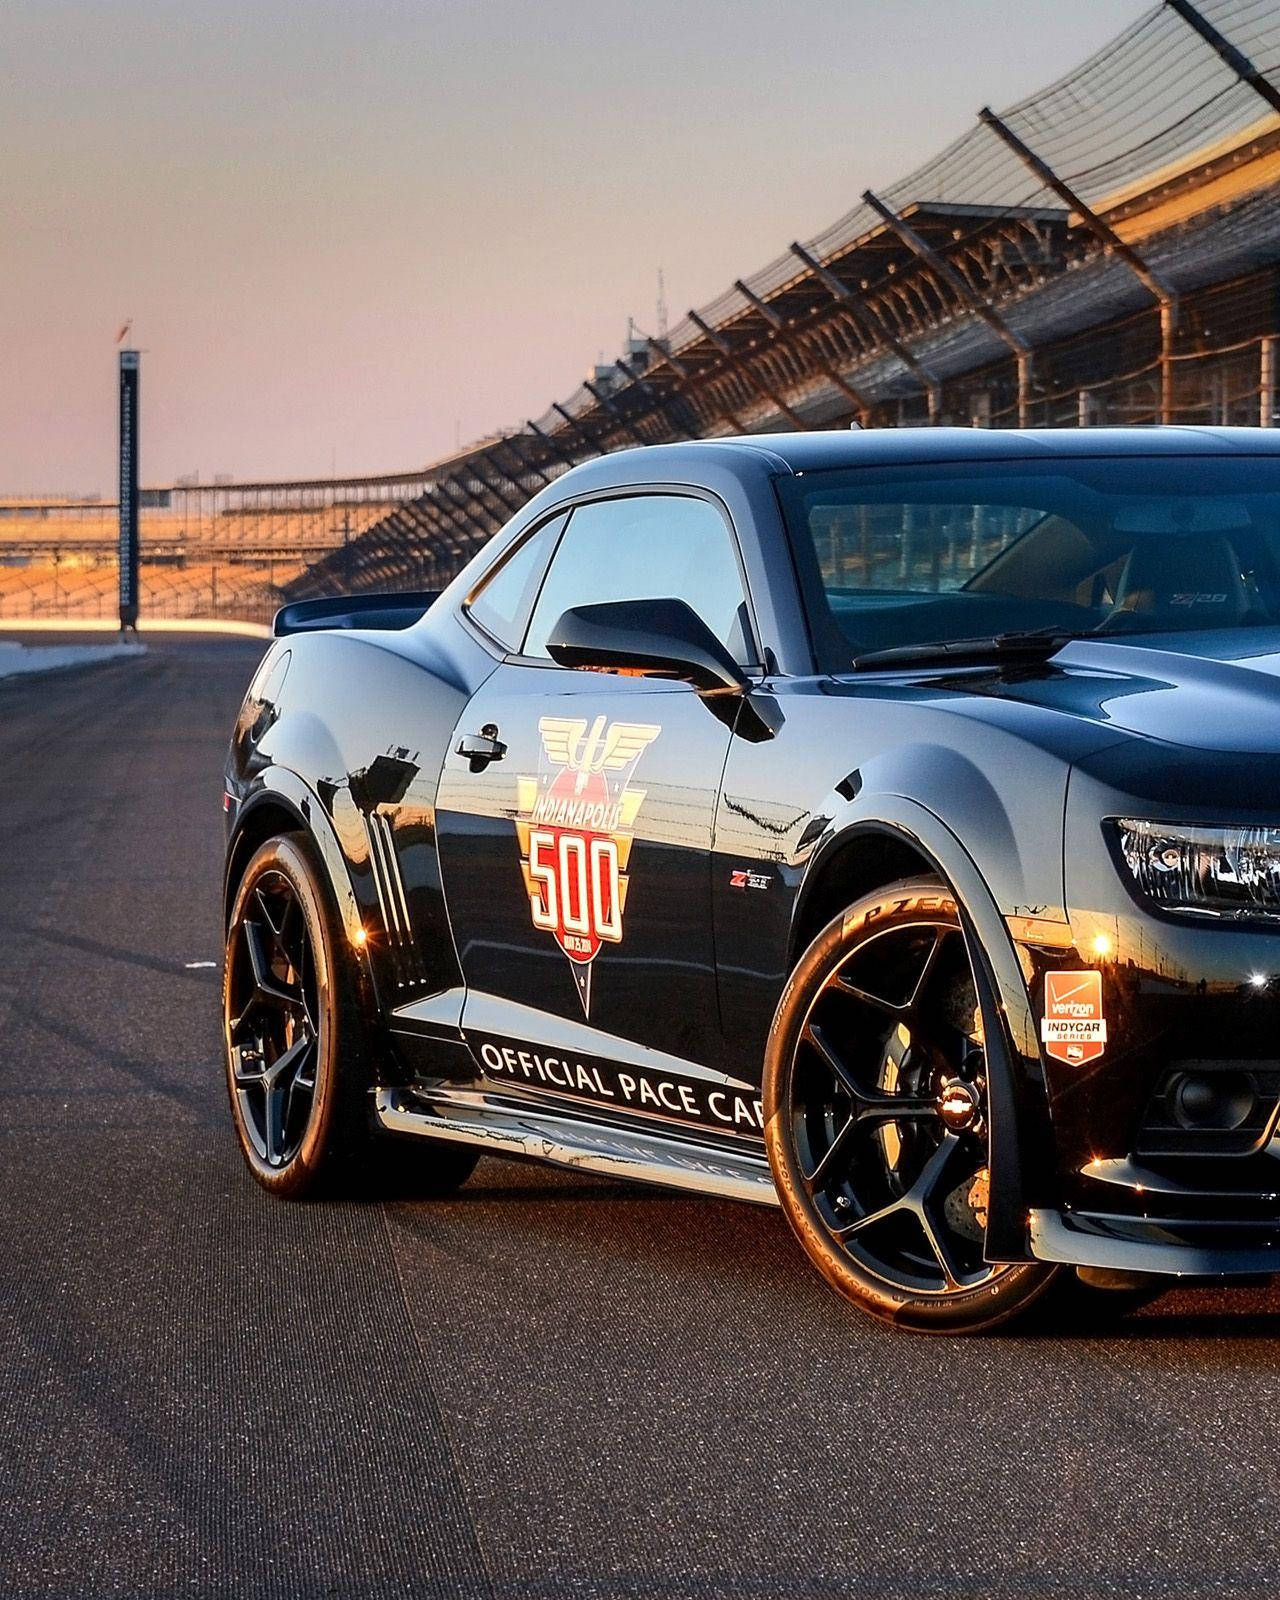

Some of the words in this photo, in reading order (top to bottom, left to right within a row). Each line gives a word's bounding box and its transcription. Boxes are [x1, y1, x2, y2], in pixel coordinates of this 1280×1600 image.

[1169, 592, 1228, 608] Z/28
[532, 795, 622, 831] INDIANAPOLIS
[528, 830, 623, 943] 500
[863, 906, 882, 926] P
[1051, 1000, 1094, 1017] verizon
[1048, 1022, 1100, 1032] INDYCAR
[481, 1043, 614, 1096] OFFICIAL
[618, 1073, 701, 1115] PACE
